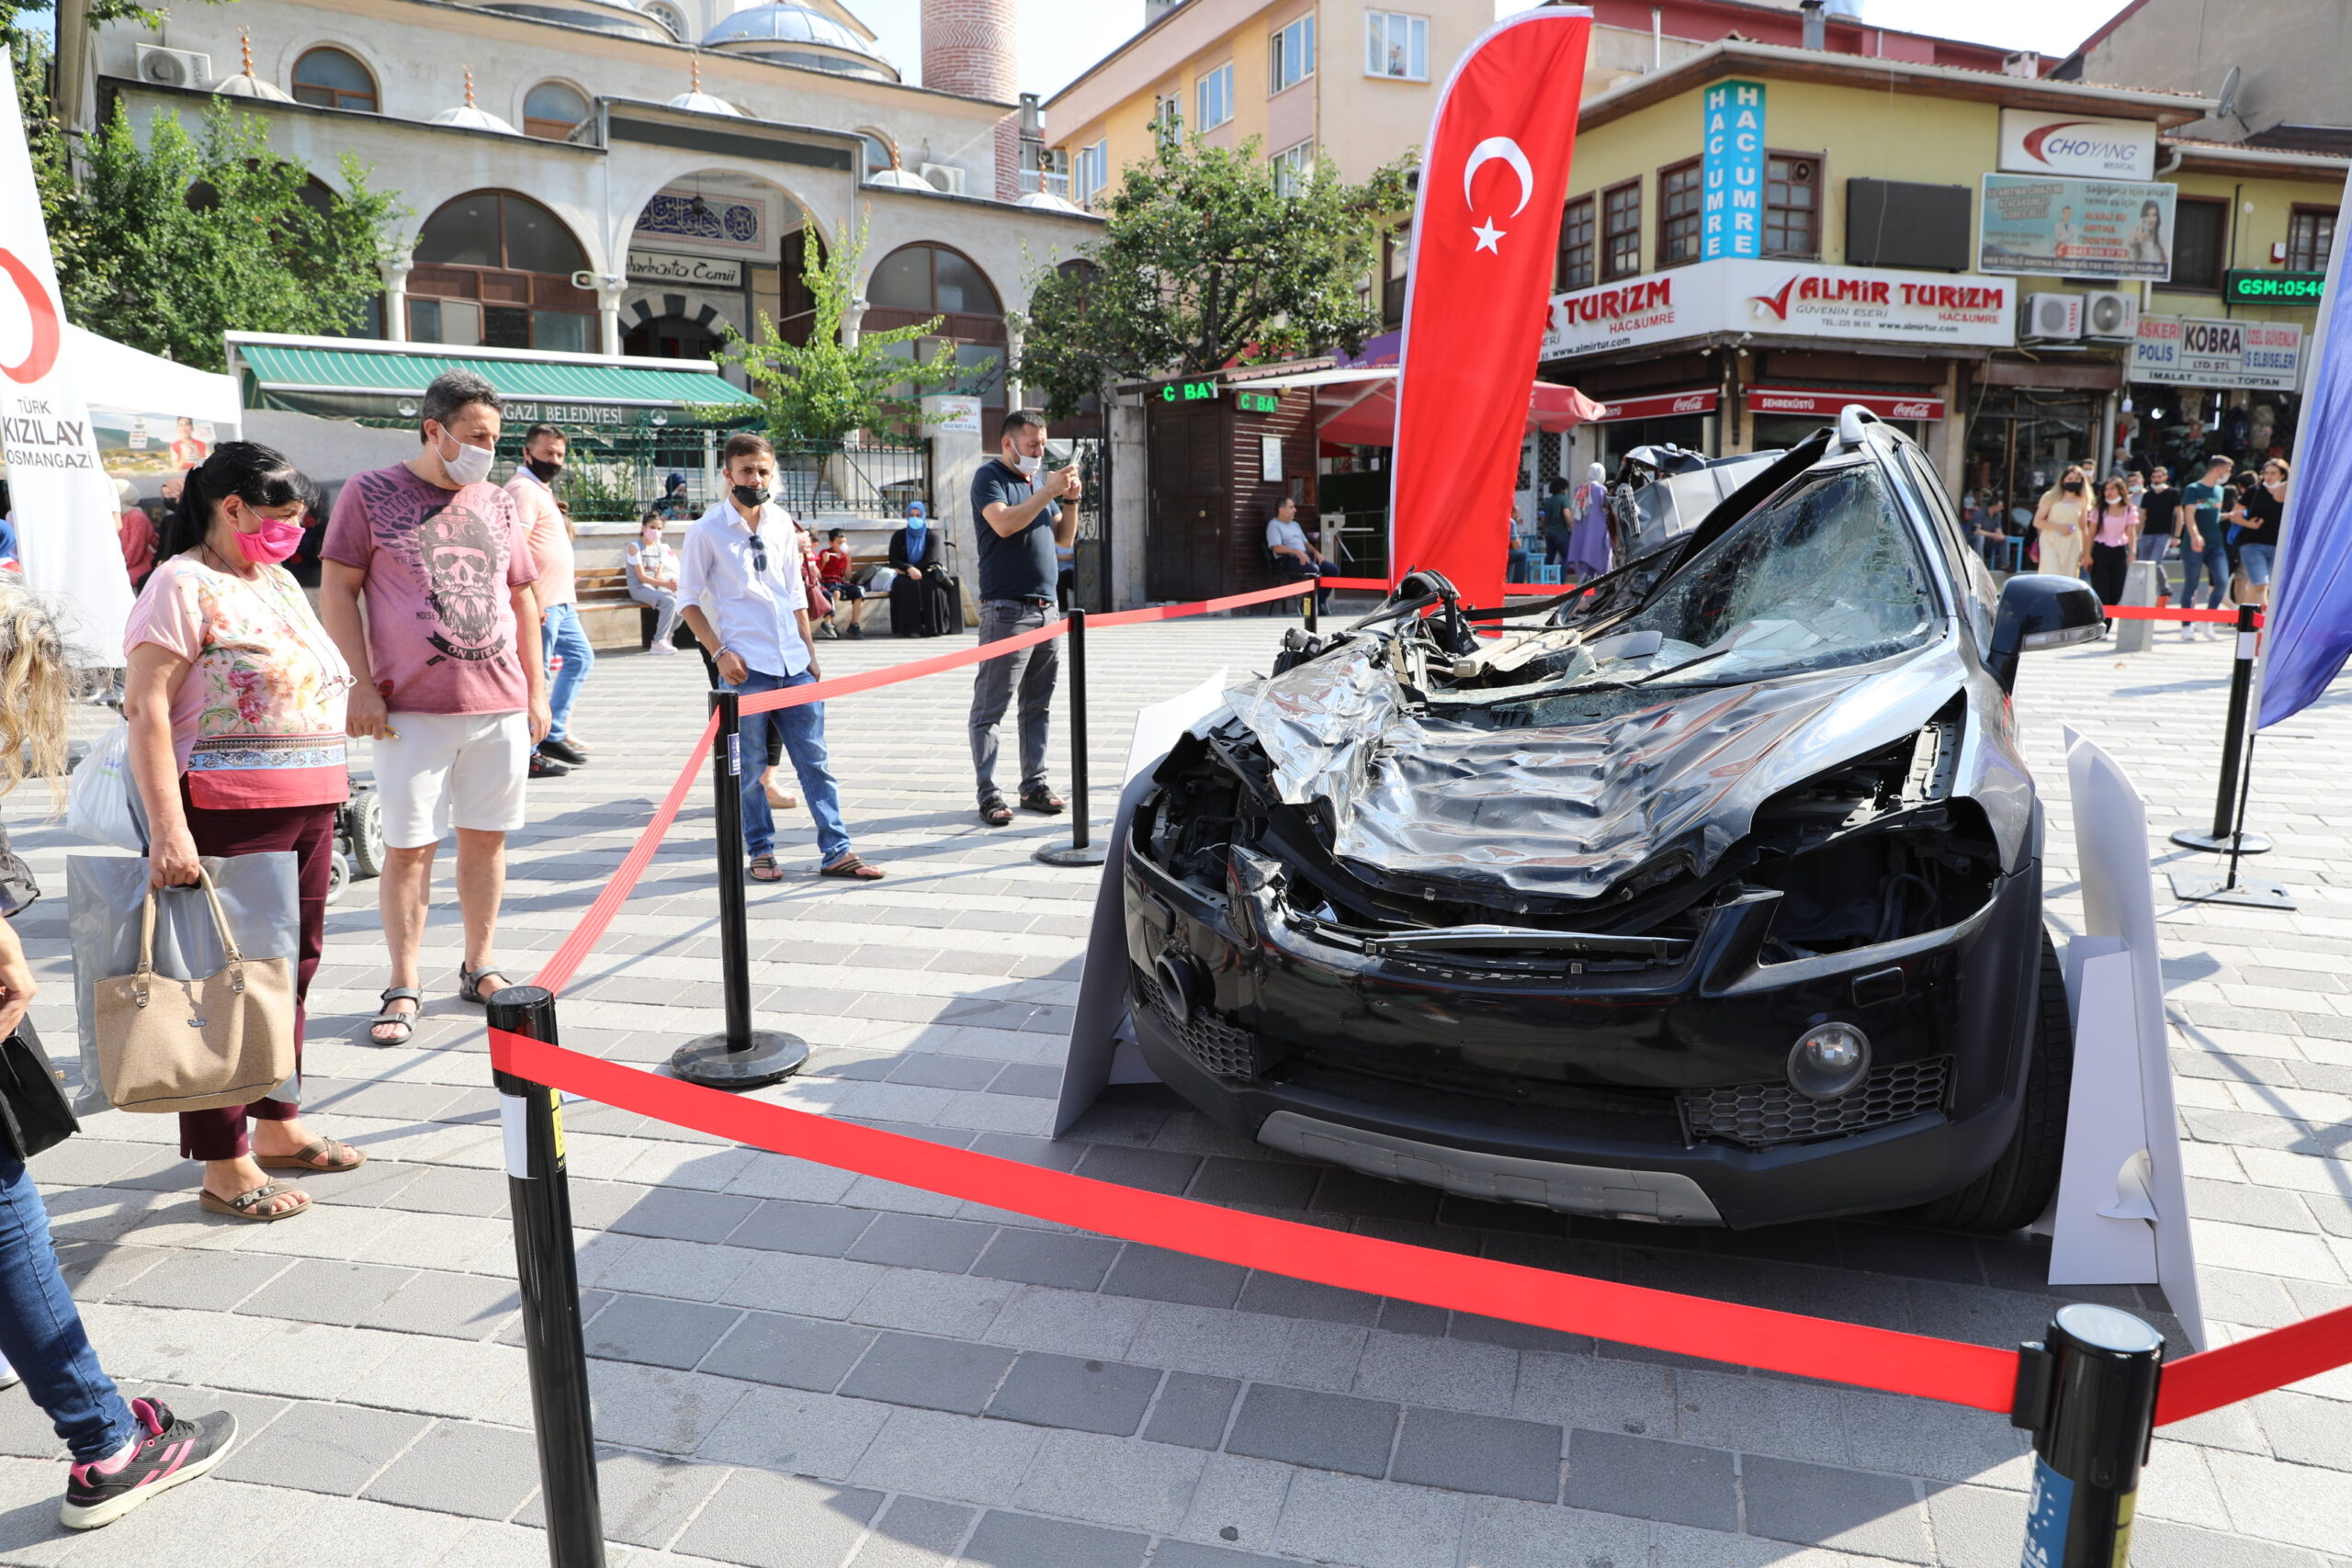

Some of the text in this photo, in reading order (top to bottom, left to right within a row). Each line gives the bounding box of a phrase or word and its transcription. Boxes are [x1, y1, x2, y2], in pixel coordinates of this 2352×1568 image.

[1710, 90, 1725, 154] HAC
[1736, 87, 1758, 152] HAC
[2048, 139, 2137, 161] CHOYANG
[1707, 168, 1724, 256] UMRE
[1733, 167, 1756, 254] UMRE
[1563, 277, 1671, 324] TURİZM
[1799, 276, 2003, 310] ALMİR TURİZM
[1609, 311, 1675, 334] HAC&UMRE
[1796, 304, 1999, 324] GÜVENİN ESERİ HAC&UMRE
[1552, 337, 1631, 358] www.almirtur.com
[2184, 325, 2241, 355] KOBRA
[2138, 343, 2174, 362] POLİS
[2192, 360, 2211, 369] LTD.
[2149, 371, 2192, 382] İMALAT
[2237, 377, 2280, 387] TOPTAN
[17, 397, 51, 414] TÜRK
[546, 404, 623, 424] BELEDİYESİ
[1761, 398, 1930, 417] ŞEHREKÜSTÜ Coca-Cola
[2, 416, 84, 446] KIZILAY
[6, 448, 94, 468] OSMANGAZİ
